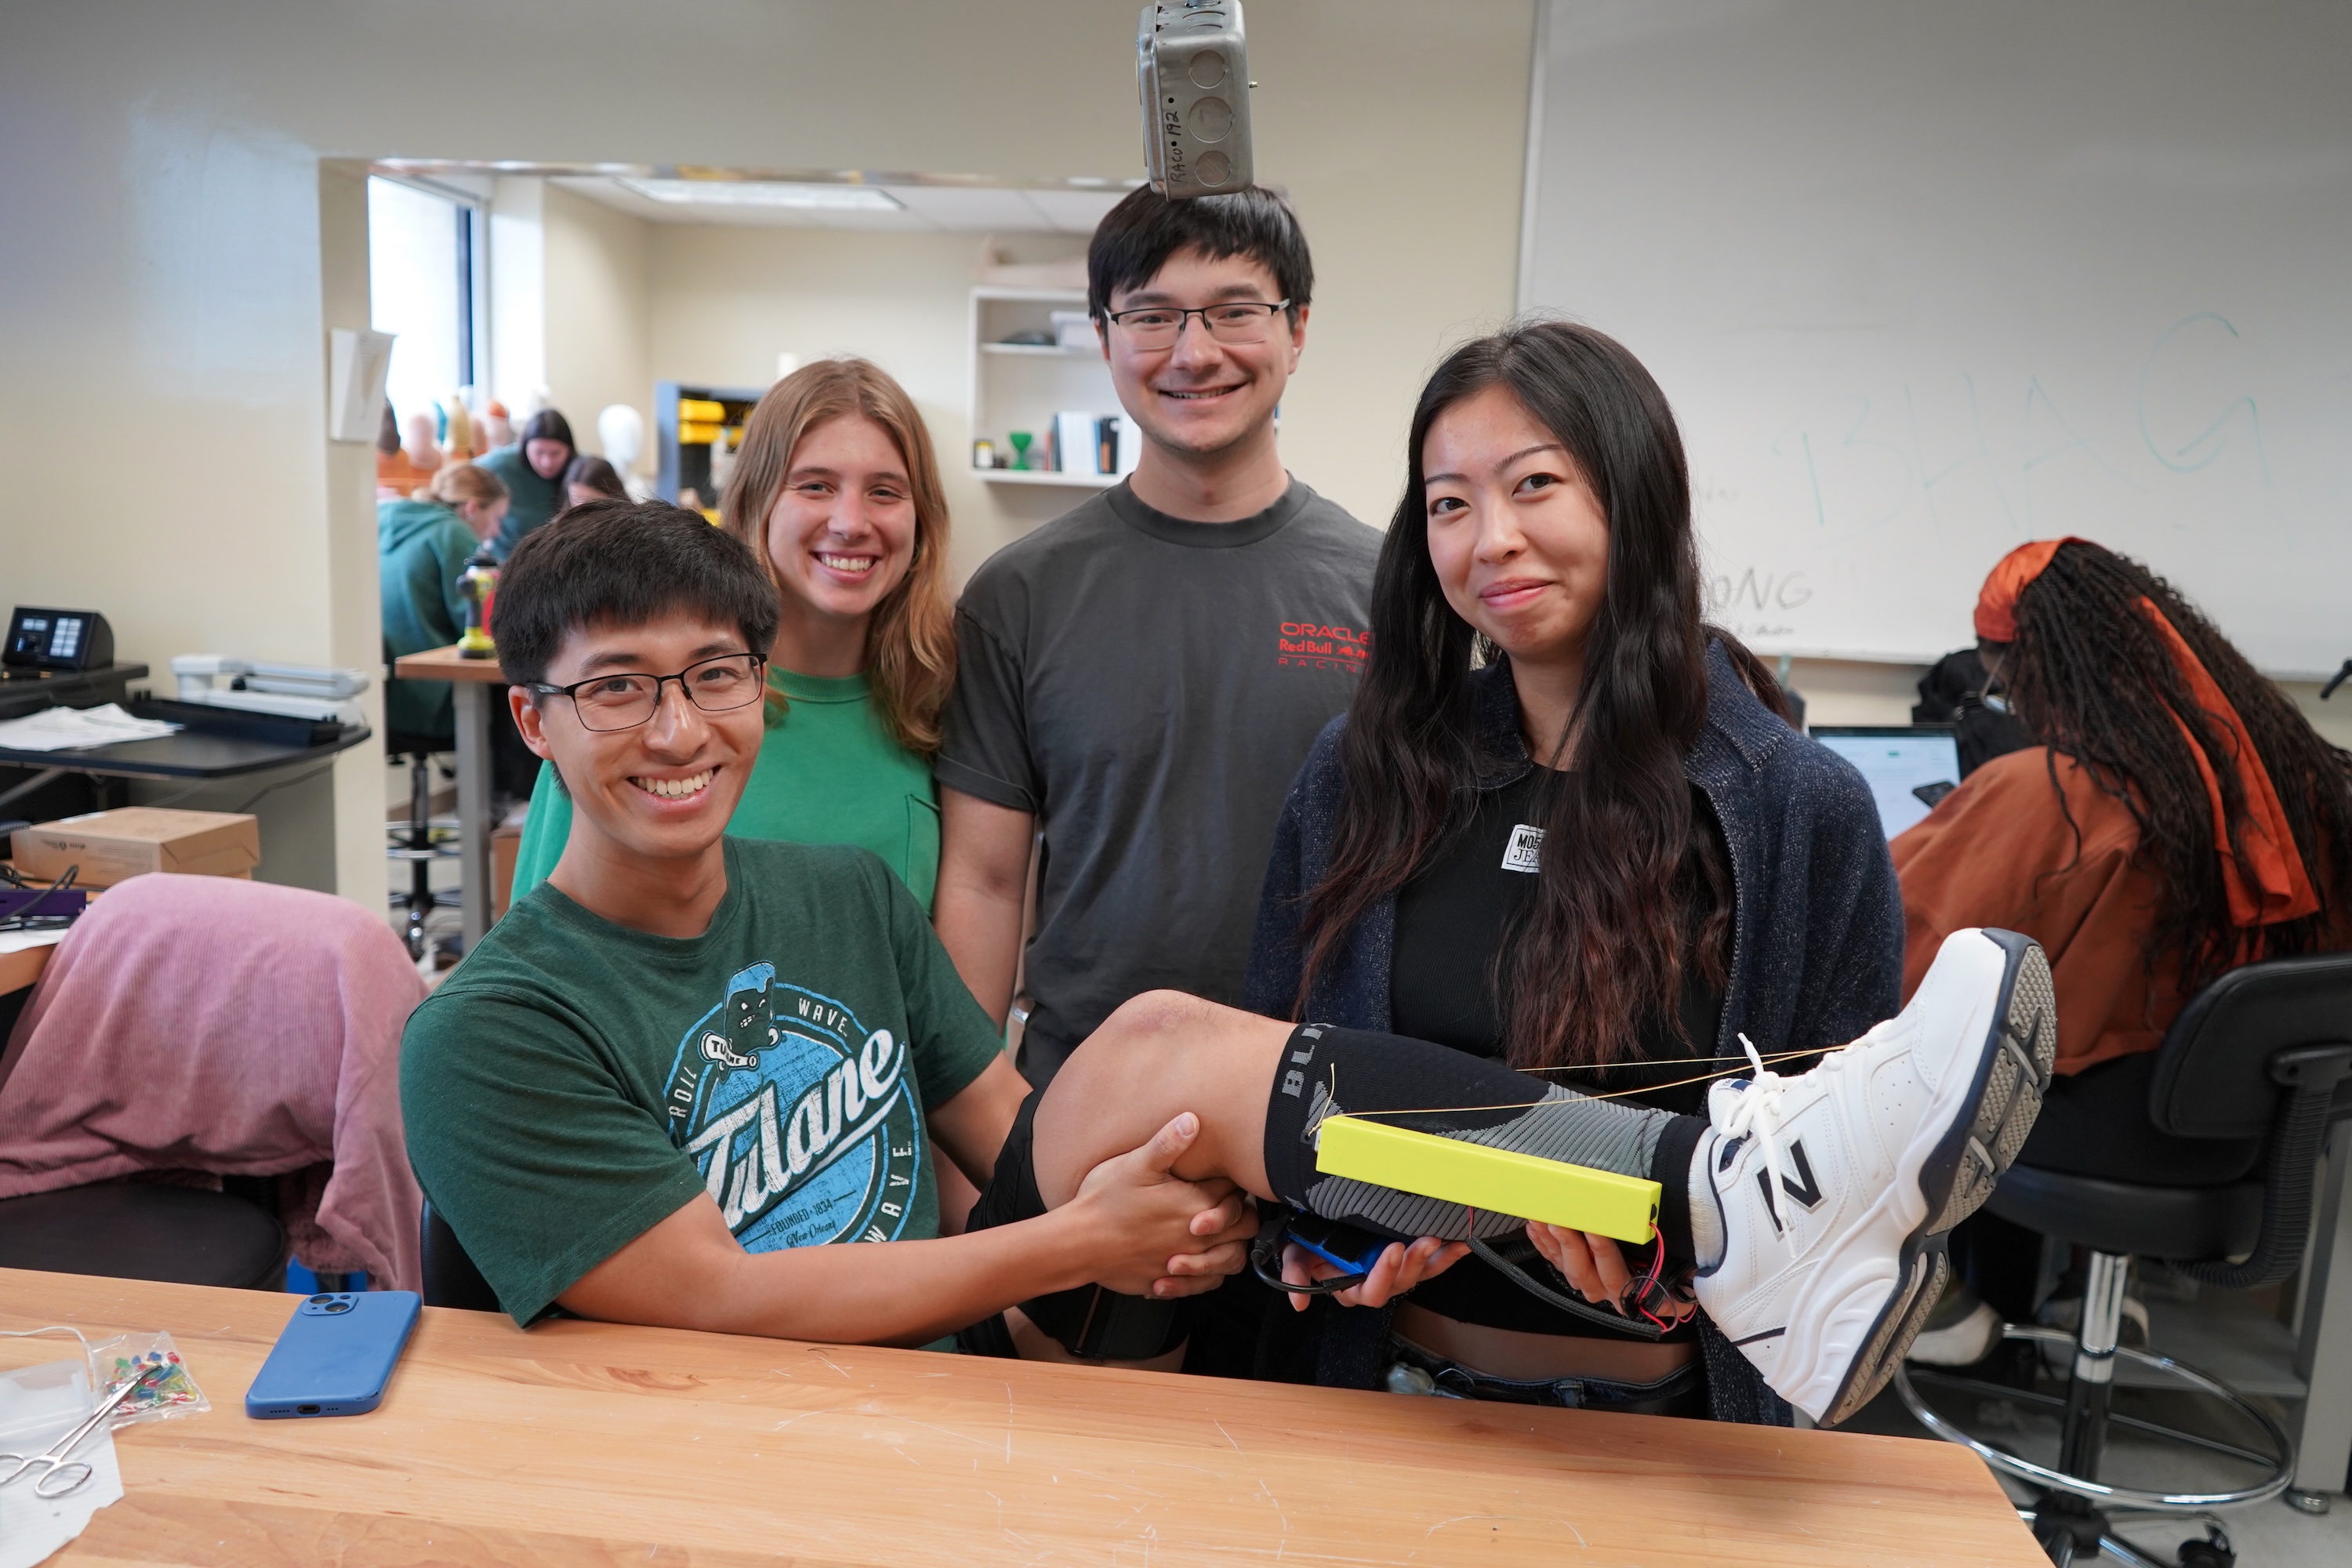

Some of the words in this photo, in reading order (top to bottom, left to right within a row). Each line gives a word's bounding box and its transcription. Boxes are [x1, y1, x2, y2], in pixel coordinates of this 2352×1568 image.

[1166, 111, 1181, 135] 192
[1279, 638, 1305, 652] Red
[1307, 641, 1331, 654] Bull
[1280, 622, 1374, 645] ORACLE
[1278, 657, 1369, 674] RACIN
[669, 1066, 697, 1118] ROLL
[798, 997, 848, 1033] WAVE
[682, 1029, 906, 1229] Tulane
[864, 1147, 912, 1243] WAVE
[770, 1208, 810, 1236] FOUNDED
[814, 1199, 833, 1216] 1834
